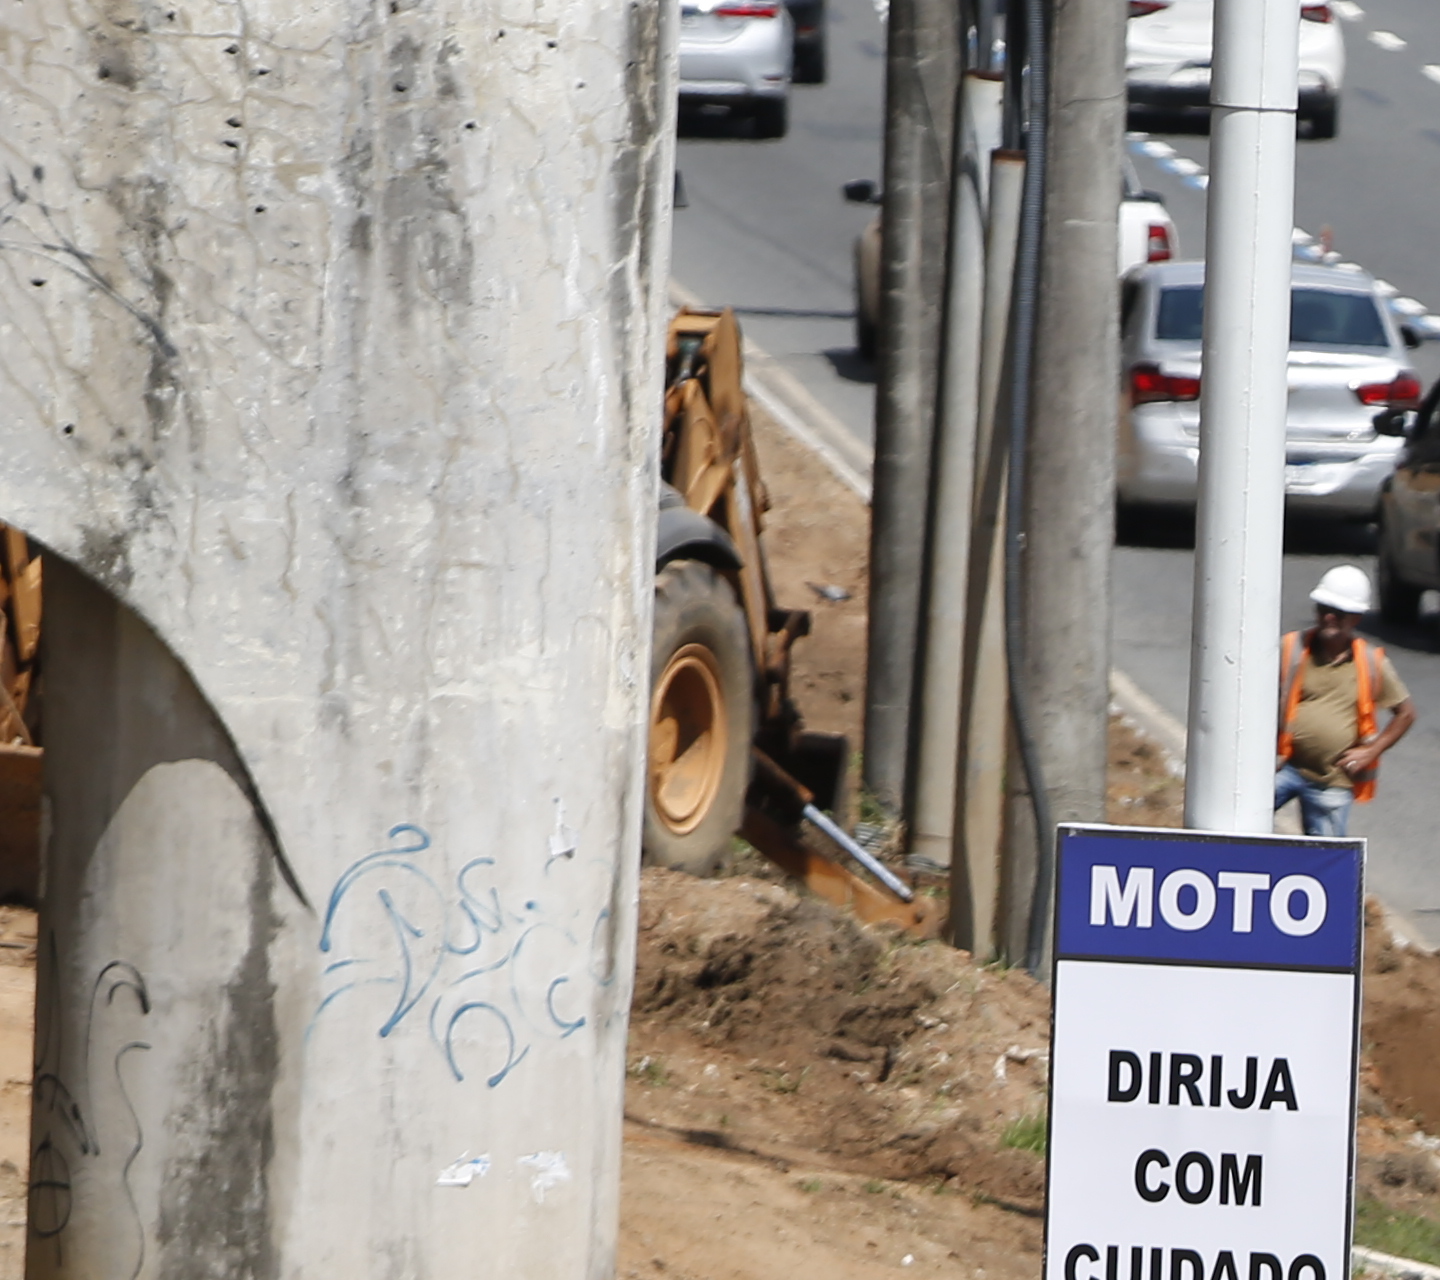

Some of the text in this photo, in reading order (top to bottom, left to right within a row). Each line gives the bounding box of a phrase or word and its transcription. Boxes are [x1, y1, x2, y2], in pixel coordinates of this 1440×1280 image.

[1090, 864, 1328, 937] MOTO
[1107, 1049, 1299, 1111] DIRIJA
[1135, 1148, 1263, 1207] COM
